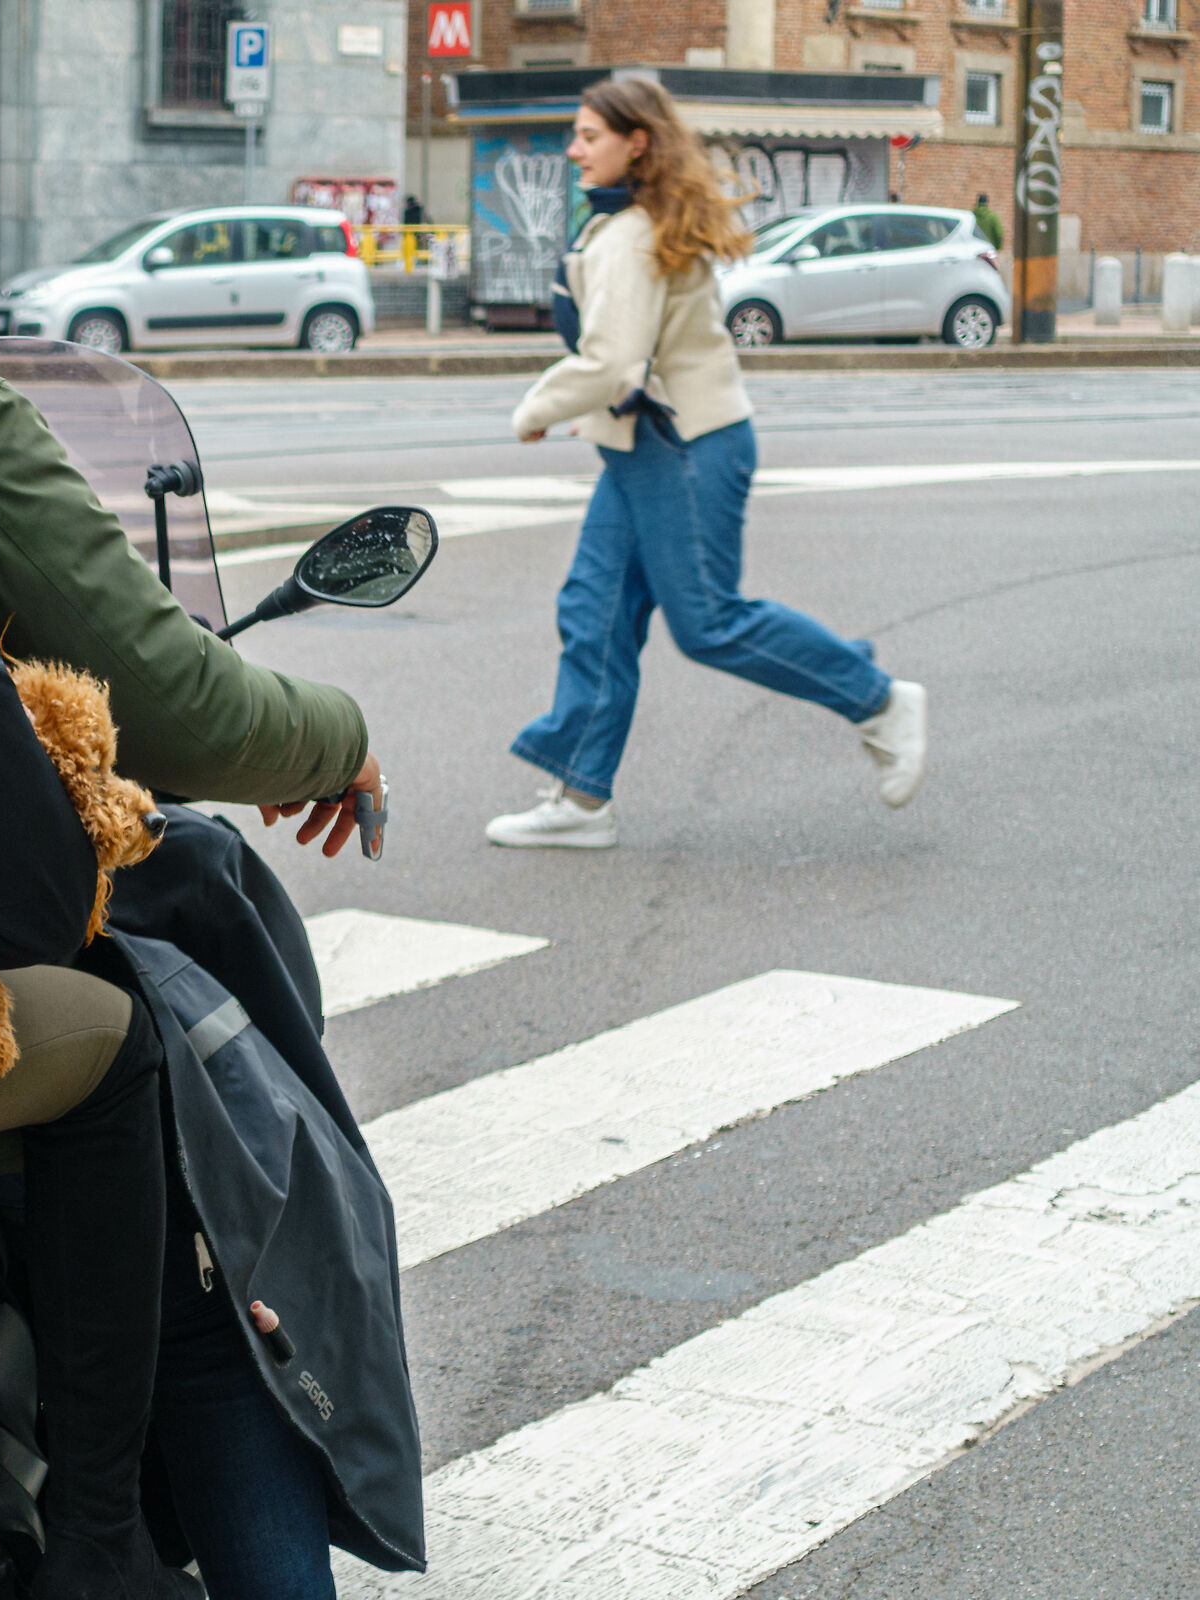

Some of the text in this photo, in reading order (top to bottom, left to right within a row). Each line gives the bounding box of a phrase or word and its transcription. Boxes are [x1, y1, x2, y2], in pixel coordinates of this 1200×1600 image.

[239, 31, 262, 64] P
[429, 10, 470, 48] M
[298, 1371, 335, 1420] SGAS
